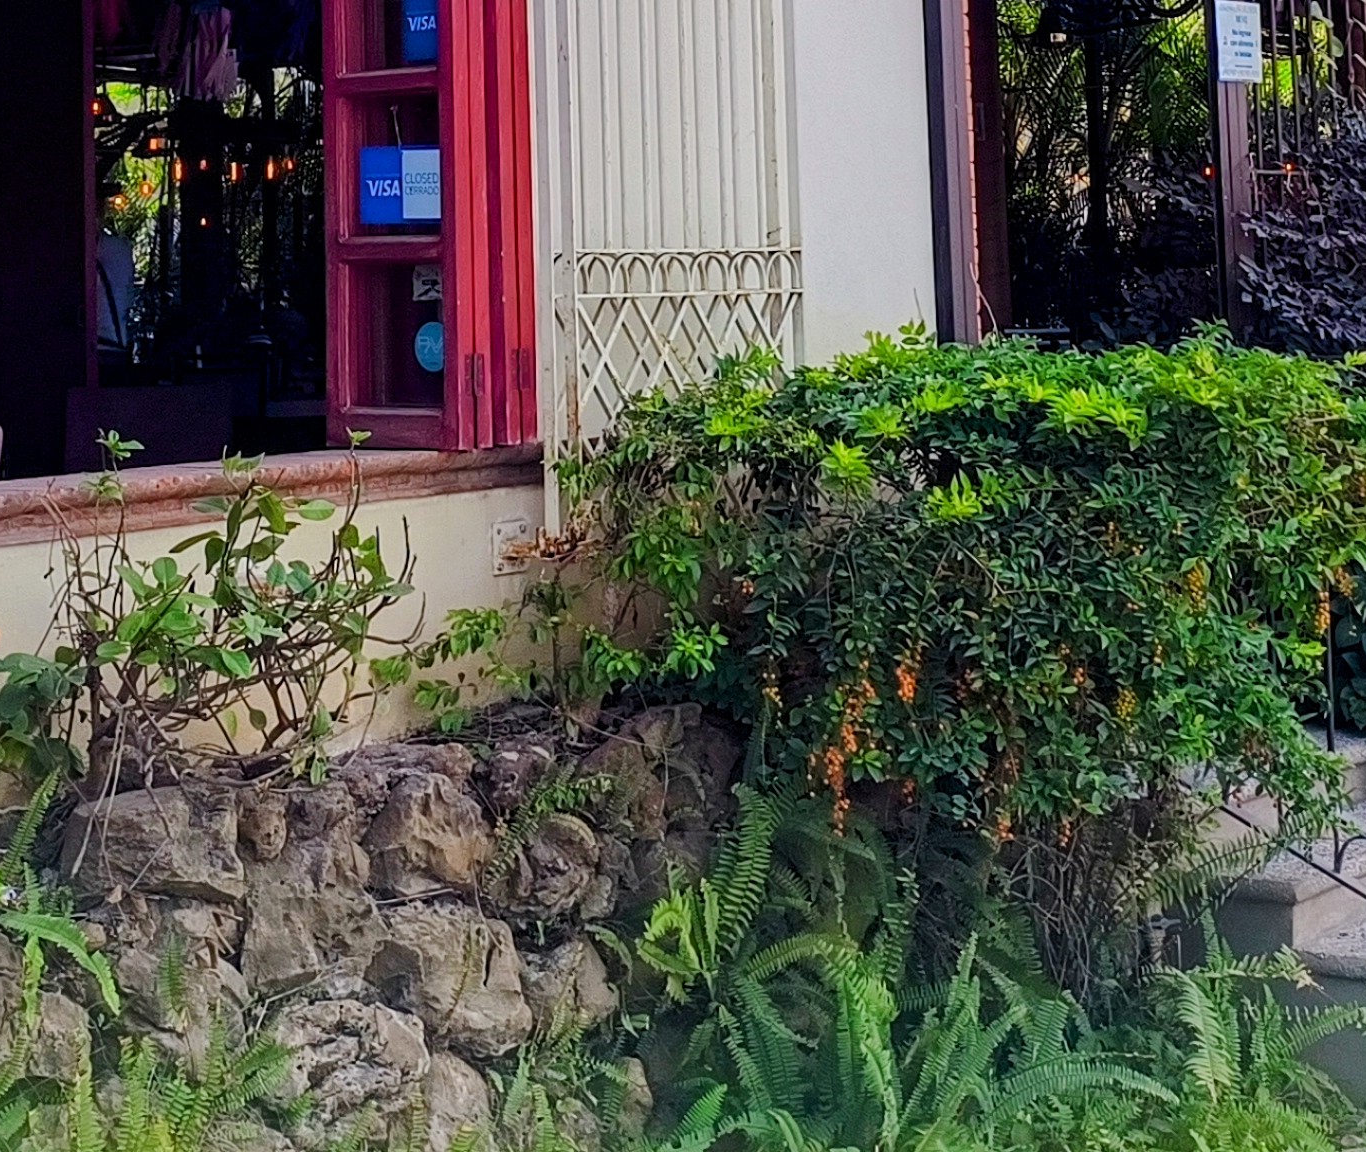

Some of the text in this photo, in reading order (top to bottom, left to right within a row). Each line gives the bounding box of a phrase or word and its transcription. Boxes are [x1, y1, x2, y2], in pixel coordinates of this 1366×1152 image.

[407, 15, 436, 32] VISA
[404, 172, 439, 184] CLOSED
[366, 179, 401, 197] VISA
